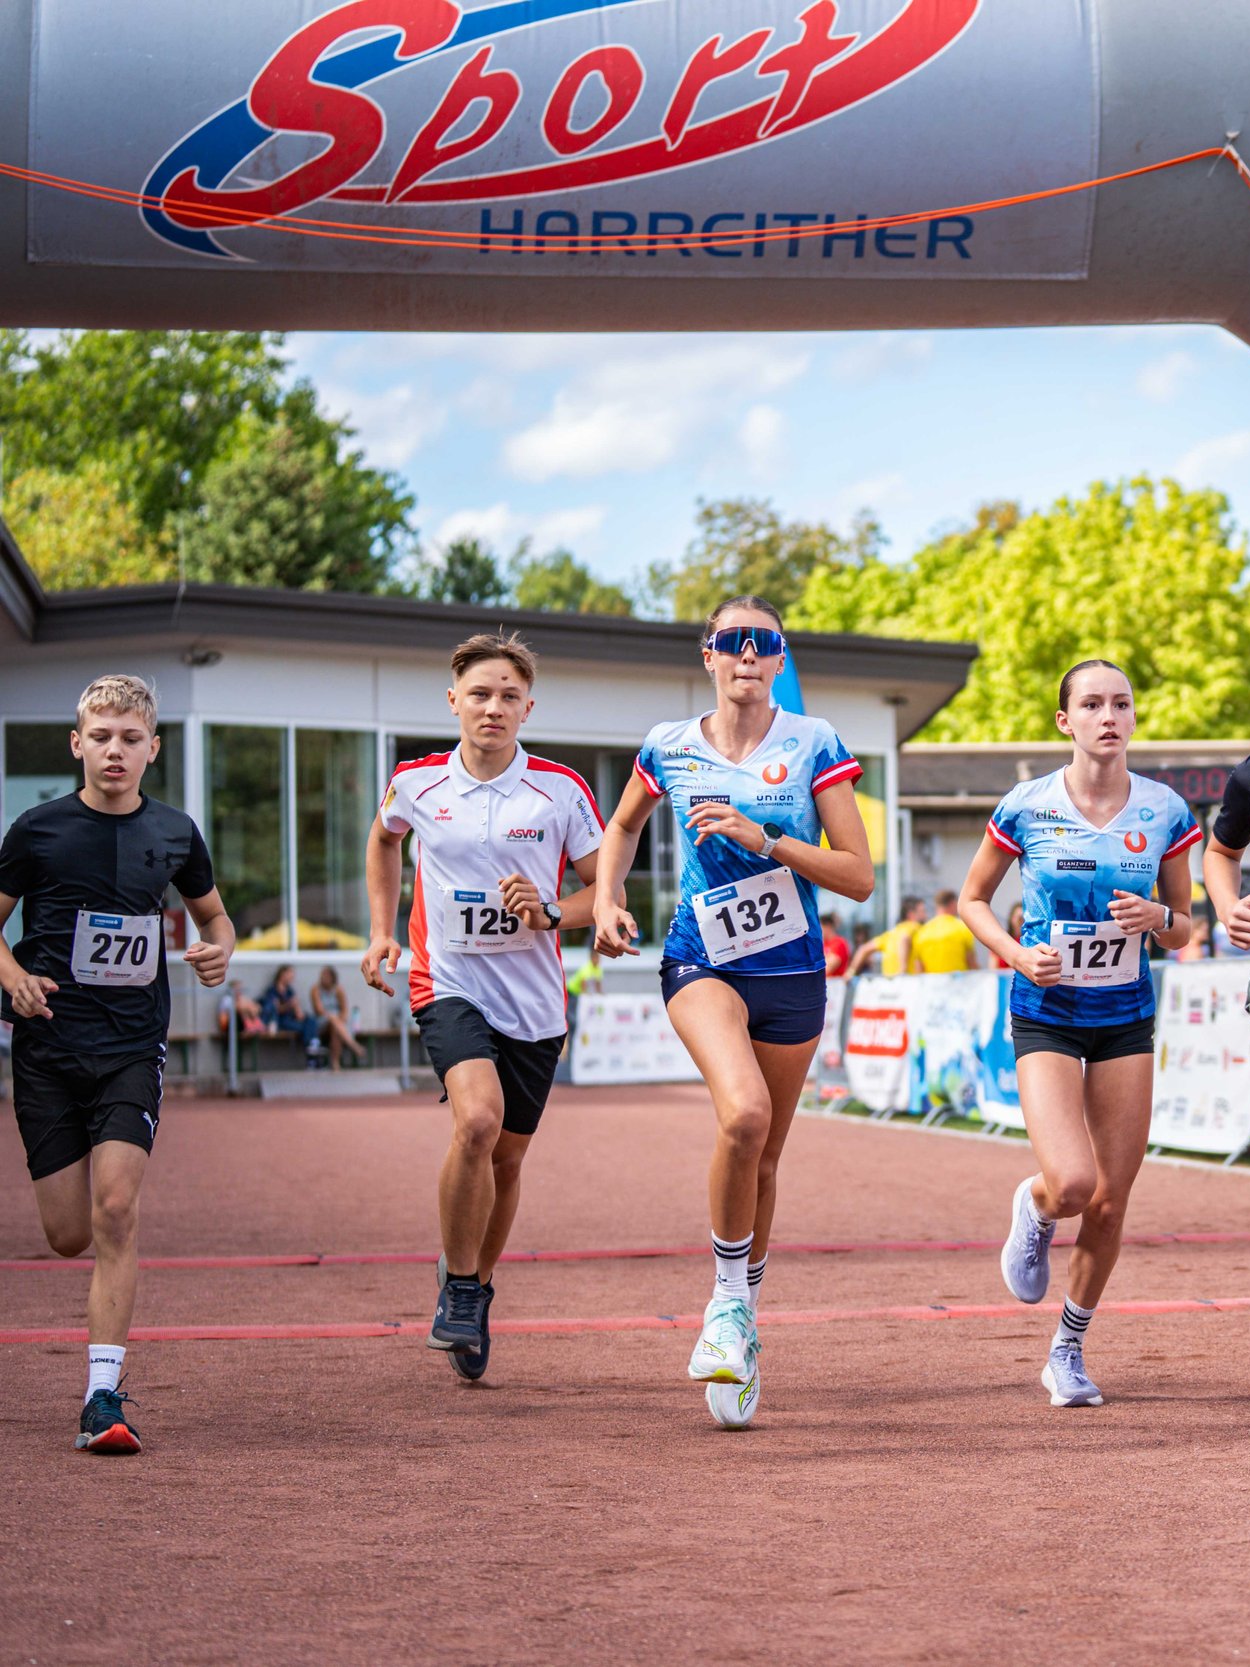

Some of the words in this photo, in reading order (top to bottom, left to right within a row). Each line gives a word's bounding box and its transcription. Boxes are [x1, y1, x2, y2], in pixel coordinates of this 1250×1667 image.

[161, 0, 860, 230] Sport
[479, 208, 974, 260] HARREITHER
[459, 906, 520, 936] 125
[715, 892, 786, 939] 132
[89, 932, 149, 967] 270
[1068, 937, 1127, 969] 127
